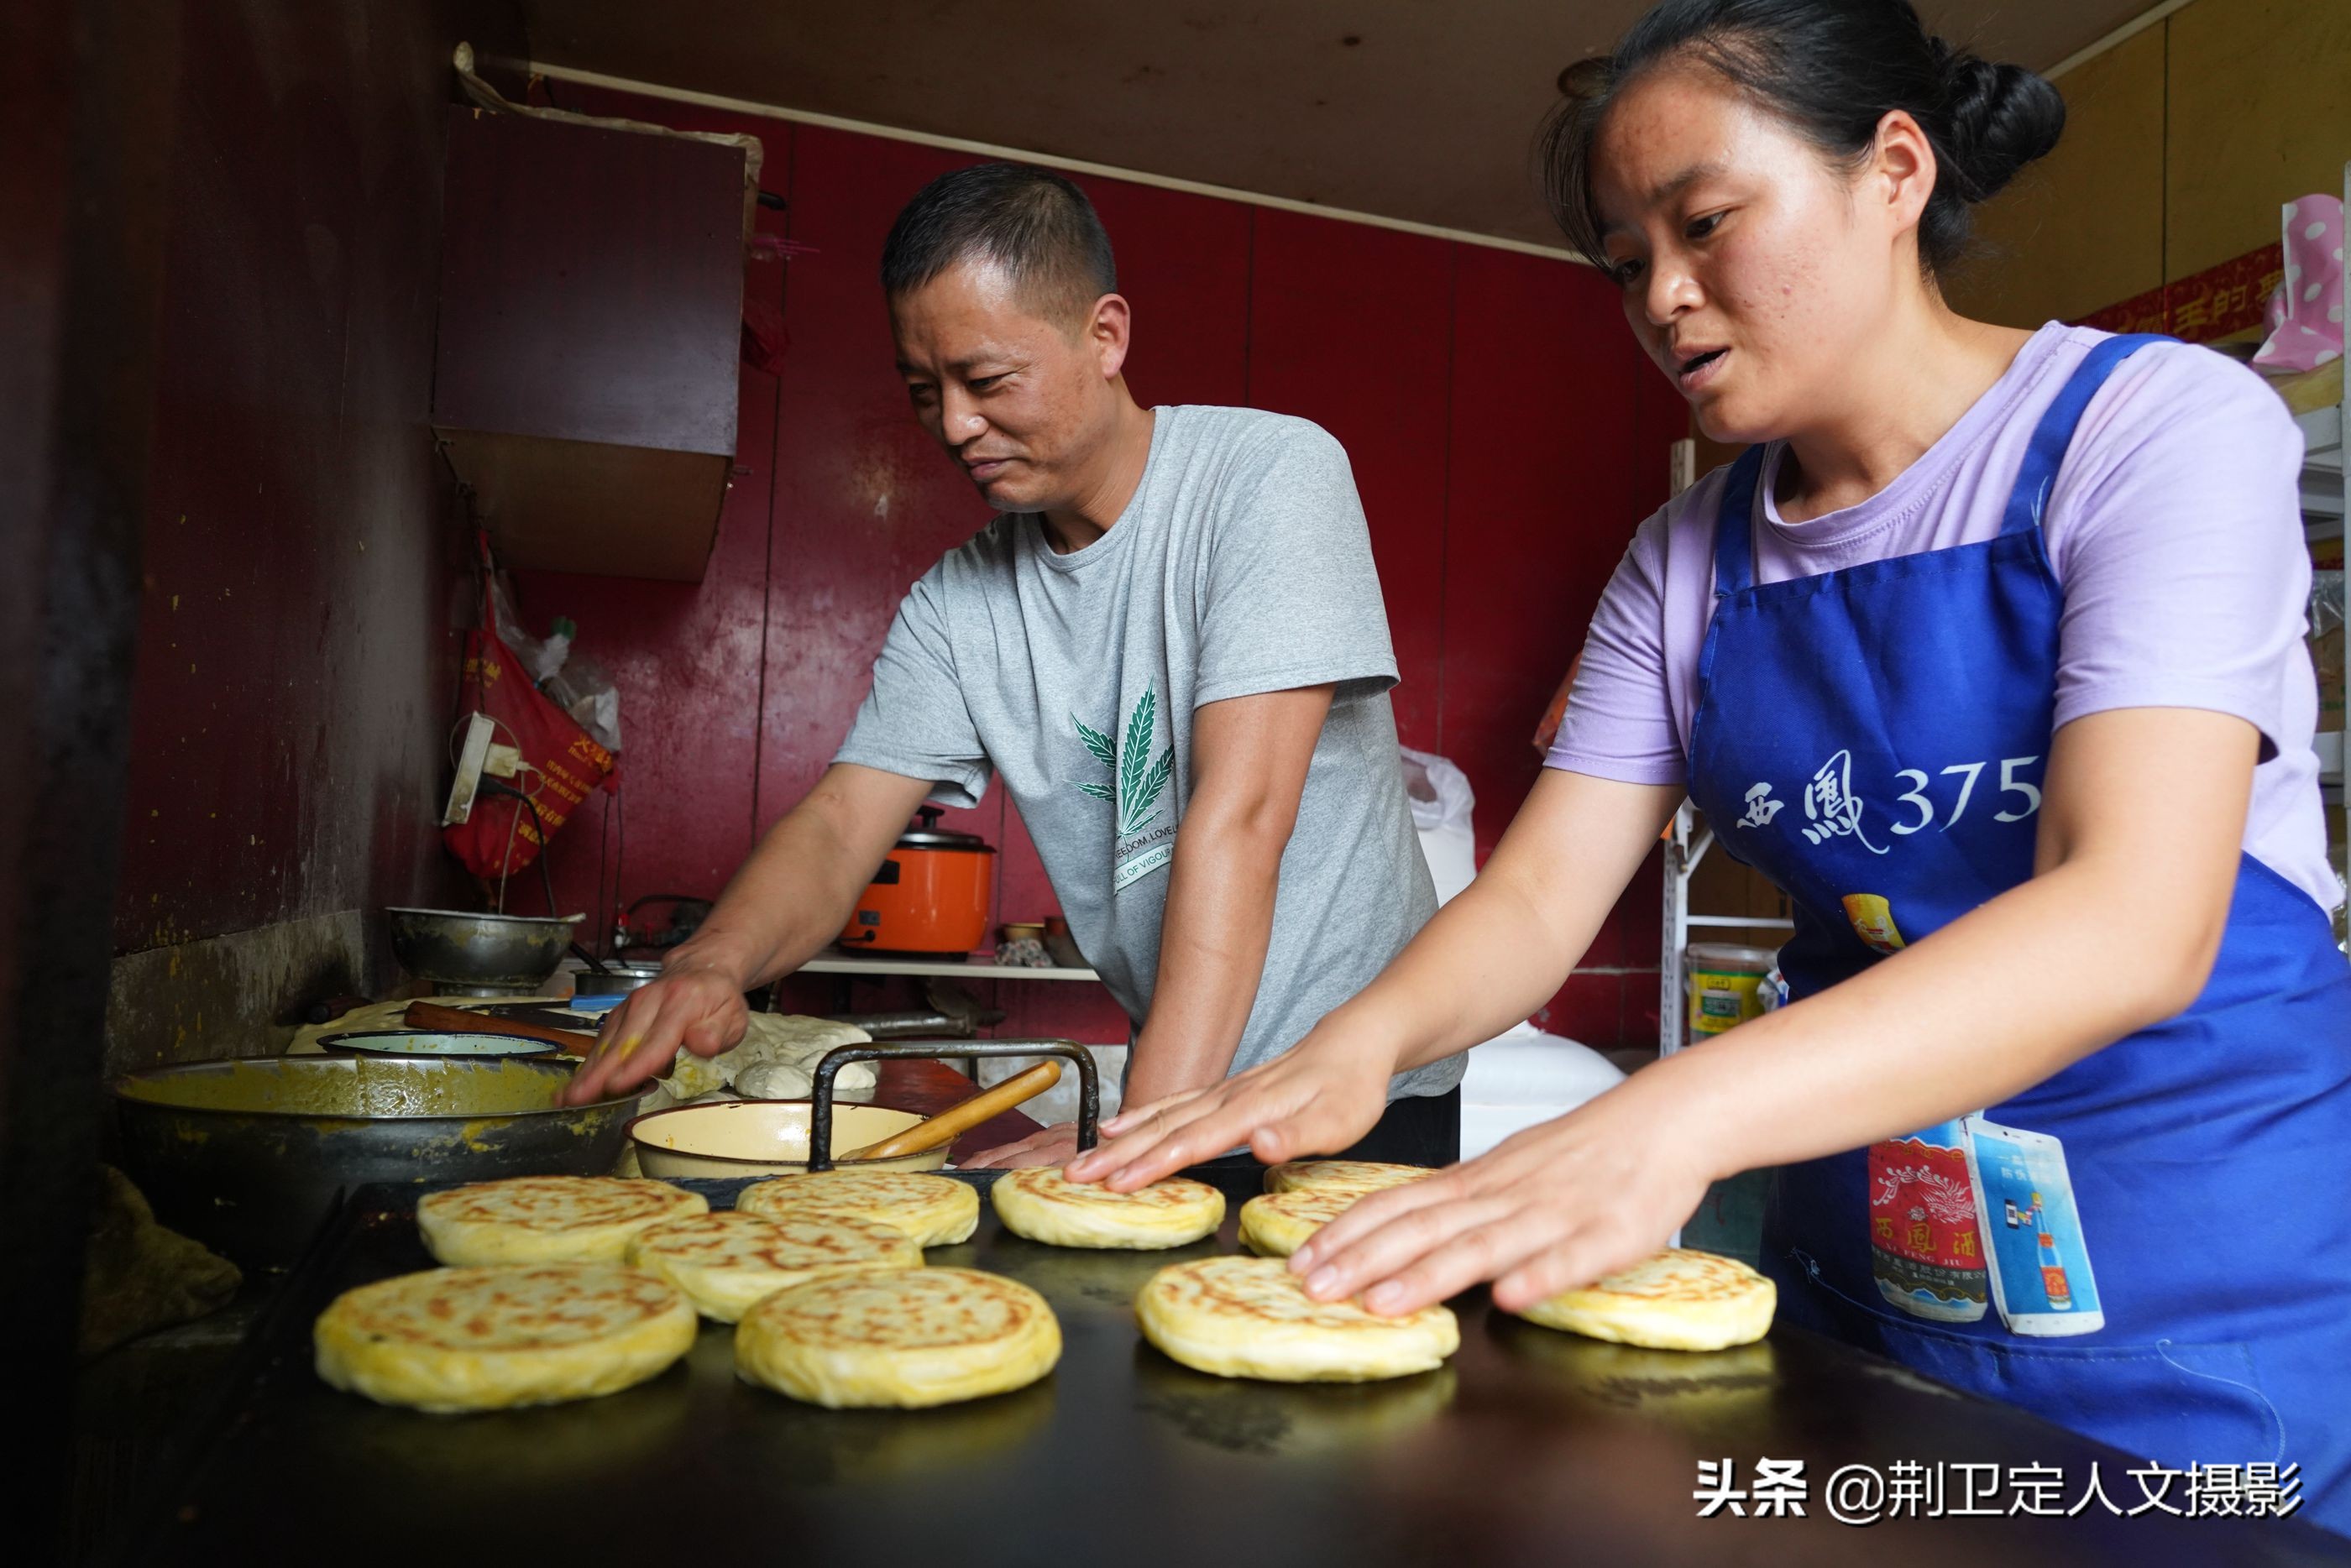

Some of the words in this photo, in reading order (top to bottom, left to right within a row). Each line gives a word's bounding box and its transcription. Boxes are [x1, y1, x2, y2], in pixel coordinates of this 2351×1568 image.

[1889, 755, 2042, 835] 375
[1115, 836, 1151, 860] EEDOM,
[1127, 865, 1139, 876] OF
